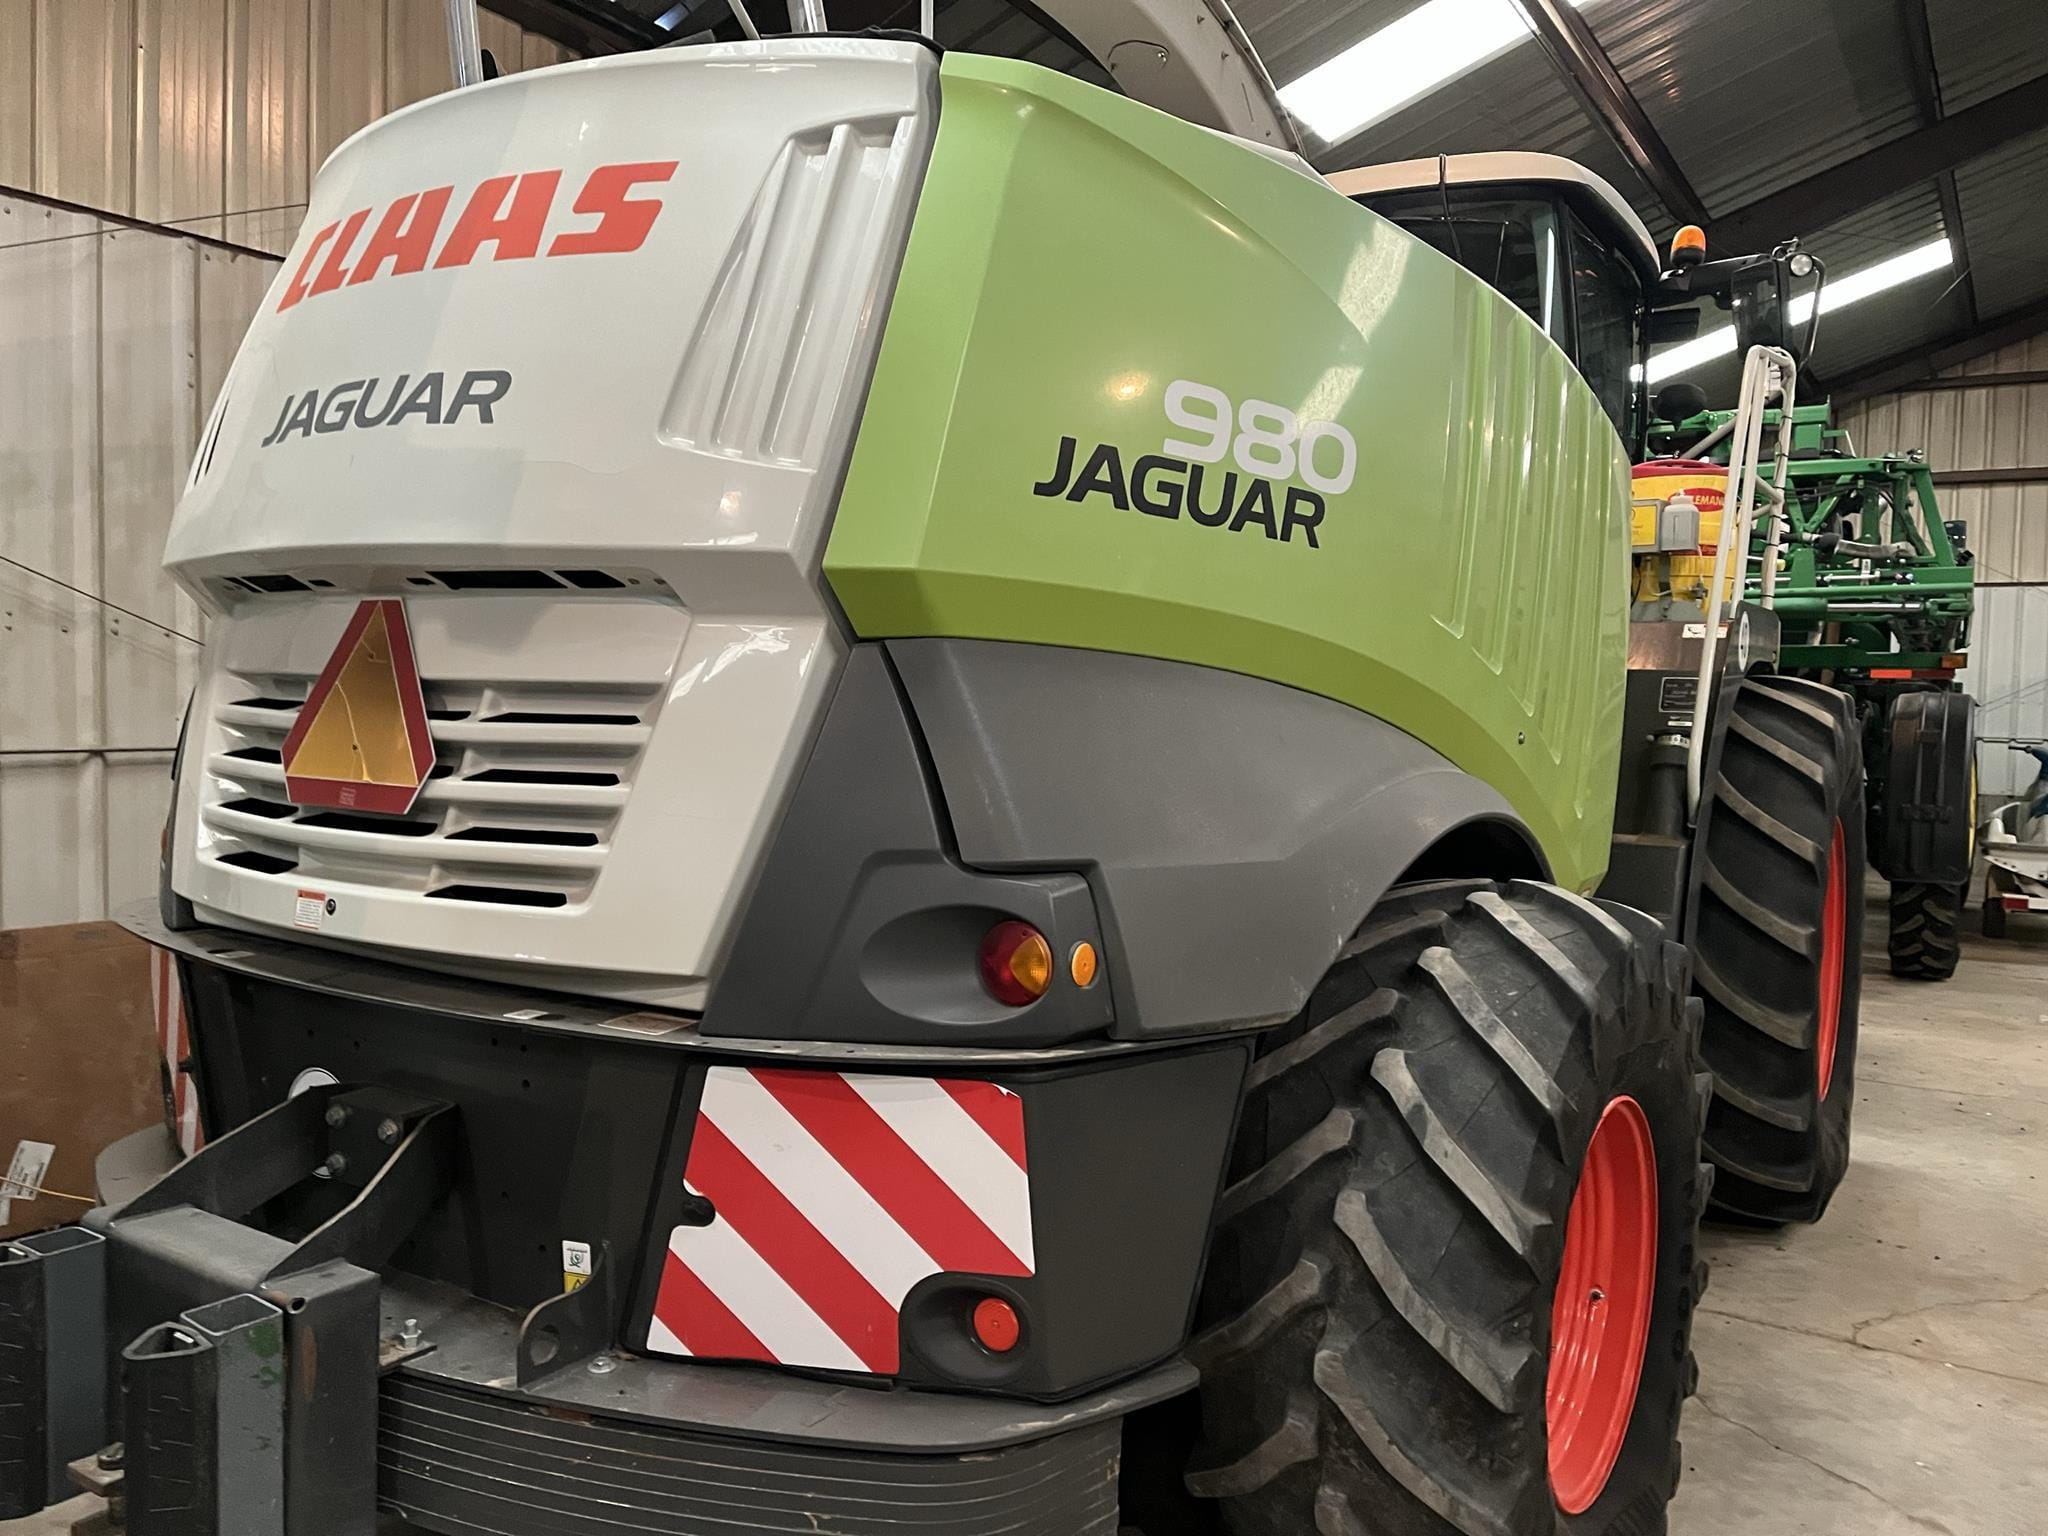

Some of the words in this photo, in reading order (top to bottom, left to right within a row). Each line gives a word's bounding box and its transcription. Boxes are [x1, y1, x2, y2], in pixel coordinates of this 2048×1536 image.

[276, 161, 680, 314] CLAAS
[261, 370, 512, 448] JAGUAR
[1163, 379, 1357, 494] 980
[1033, 436, 1325, 548] JAGUAR
